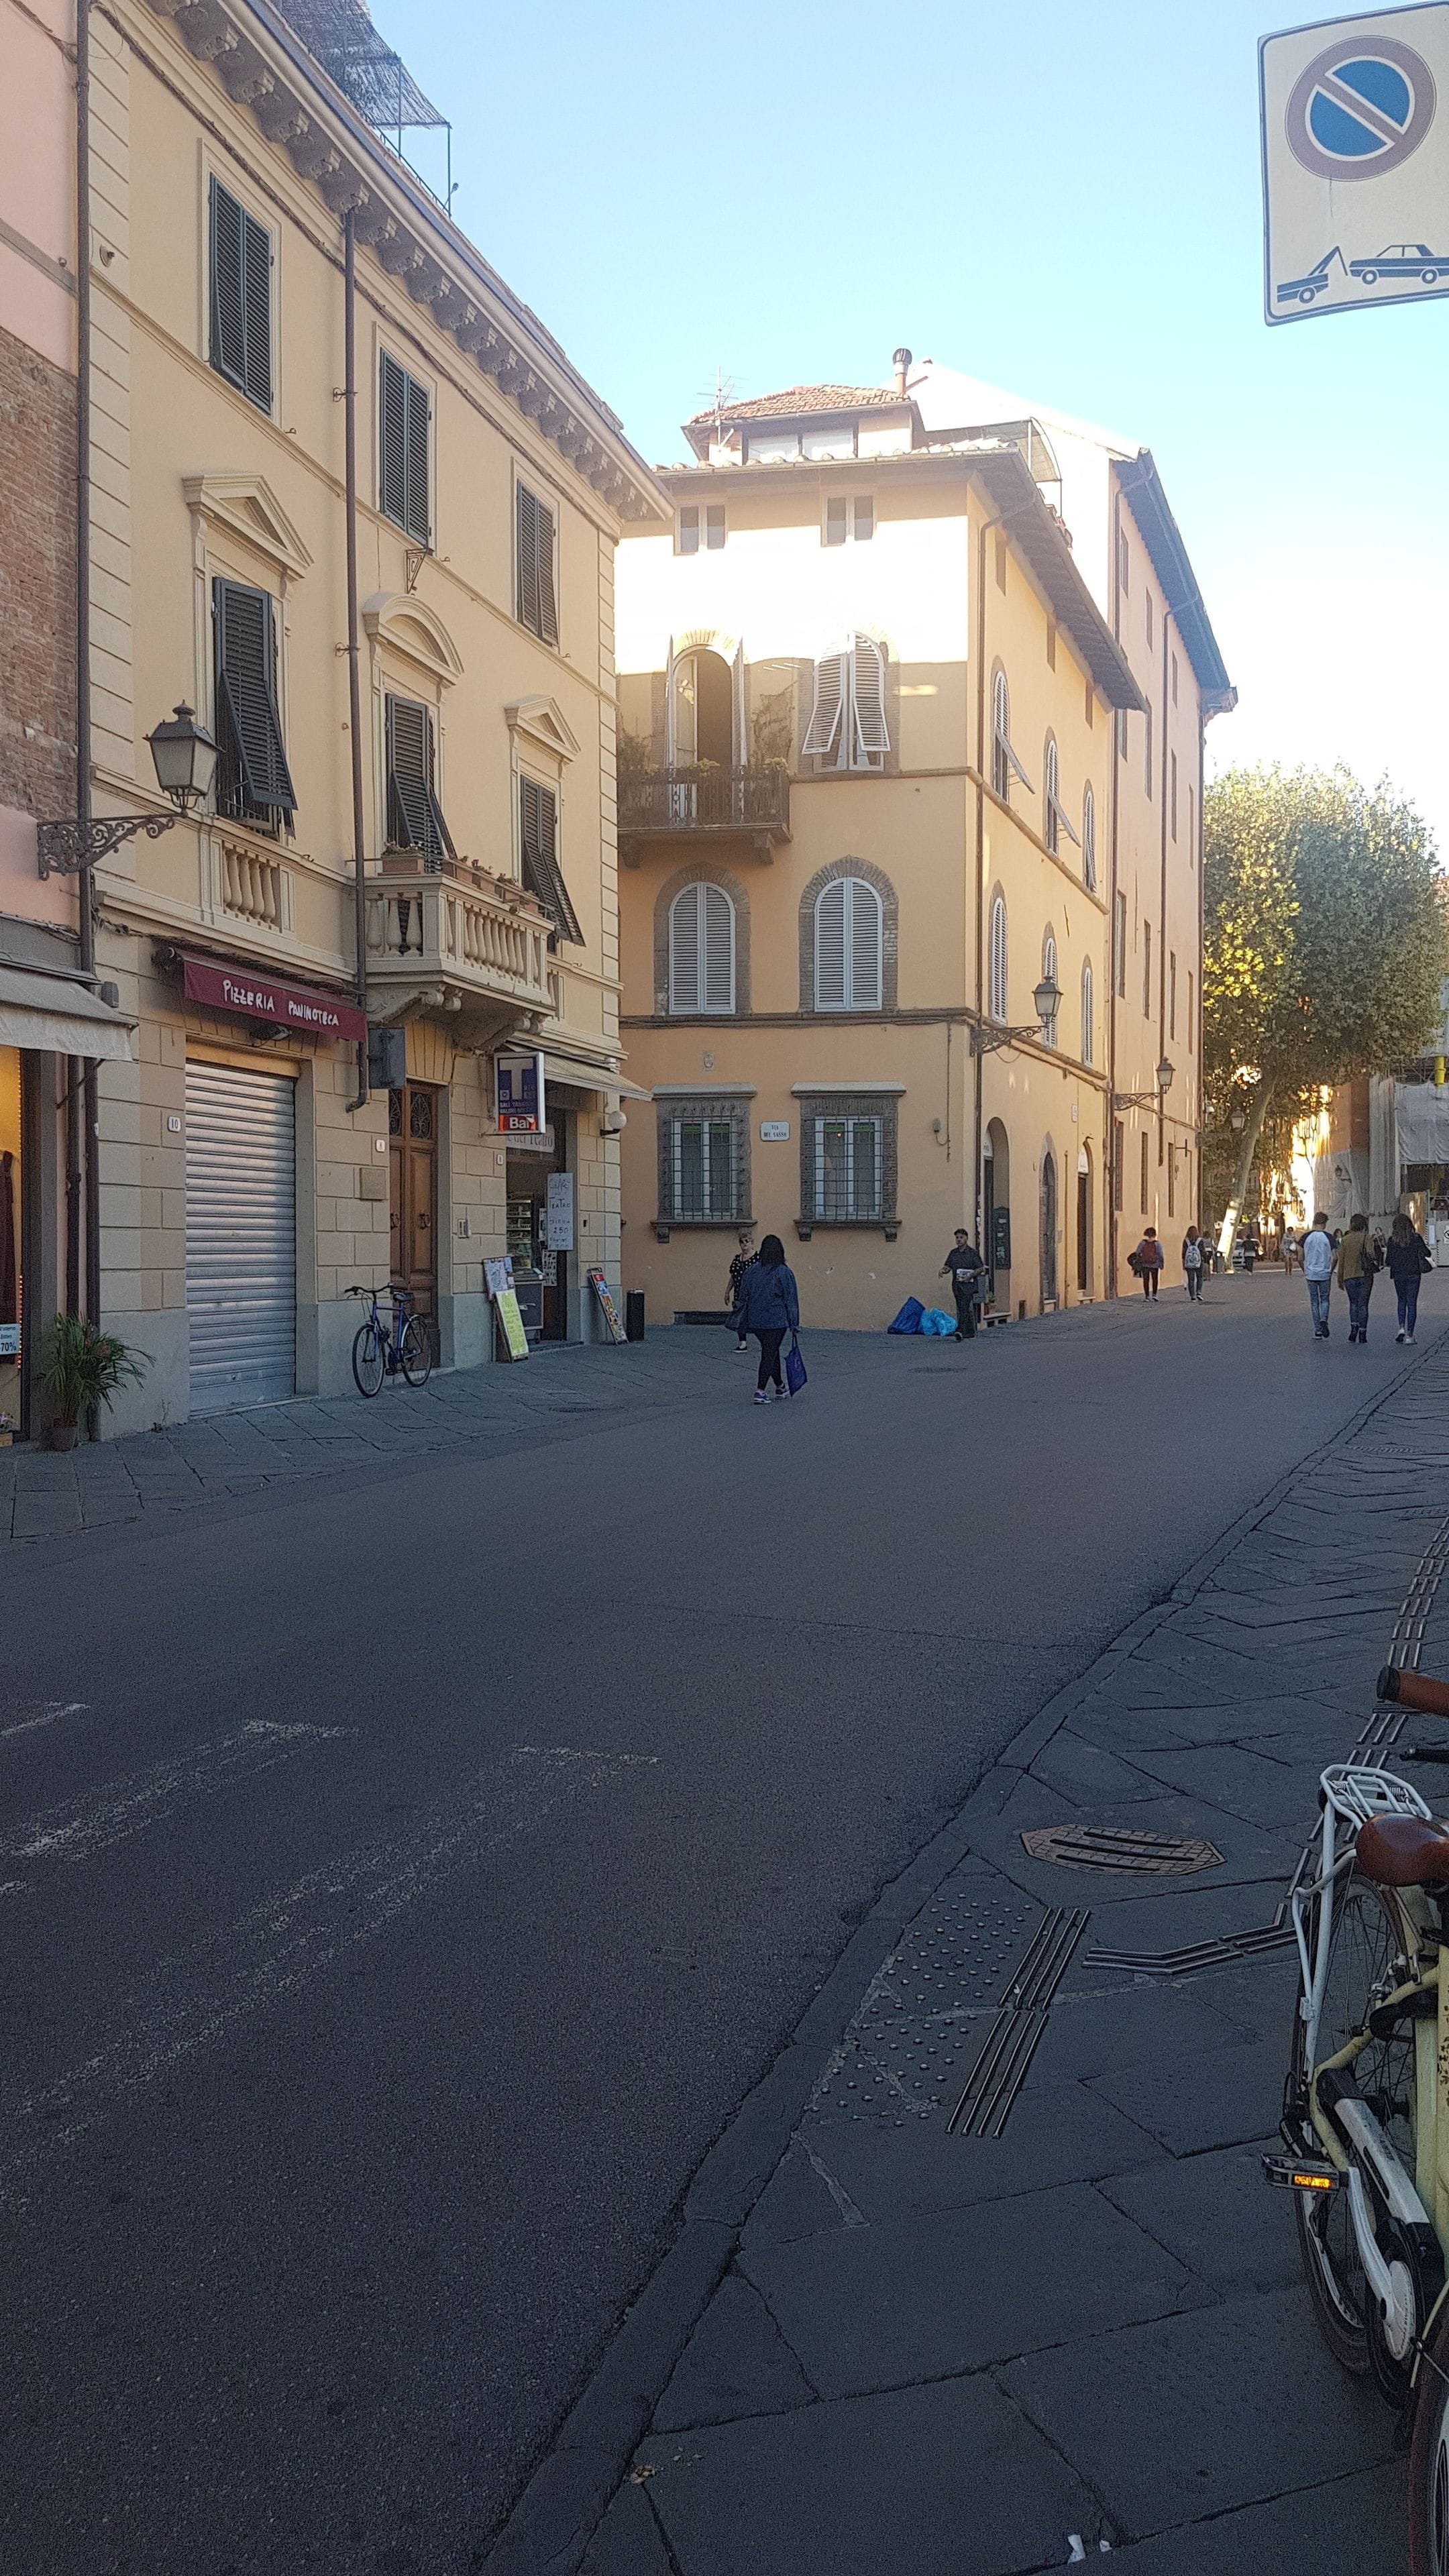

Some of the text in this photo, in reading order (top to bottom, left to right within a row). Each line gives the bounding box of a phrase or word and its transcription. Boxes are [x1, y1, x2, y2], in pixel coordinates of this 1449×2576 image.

[223, 979, 339, 1026] PIZZERIA PANINOTECA
[172, 1118, 178, 1129] 10
